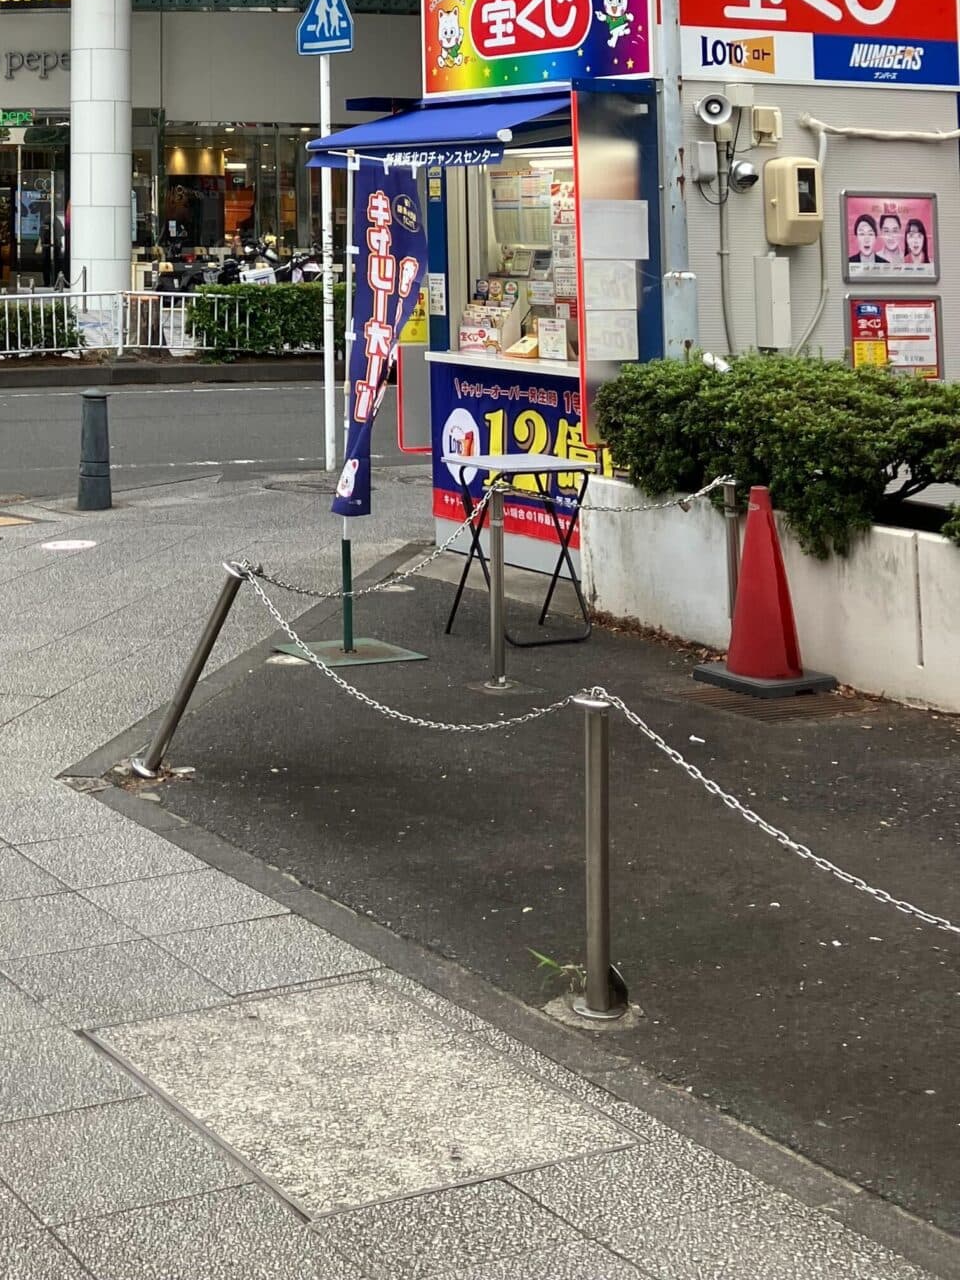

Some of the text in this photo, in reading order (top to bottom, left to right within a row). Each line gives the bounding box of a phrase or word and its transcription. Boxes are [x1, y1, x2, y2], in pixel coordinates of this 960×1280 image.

[5, 49, 72, 81] pepe
[701, 35, 743, 67] LOTO
[849, 42, 924, 70] NUMBERS
